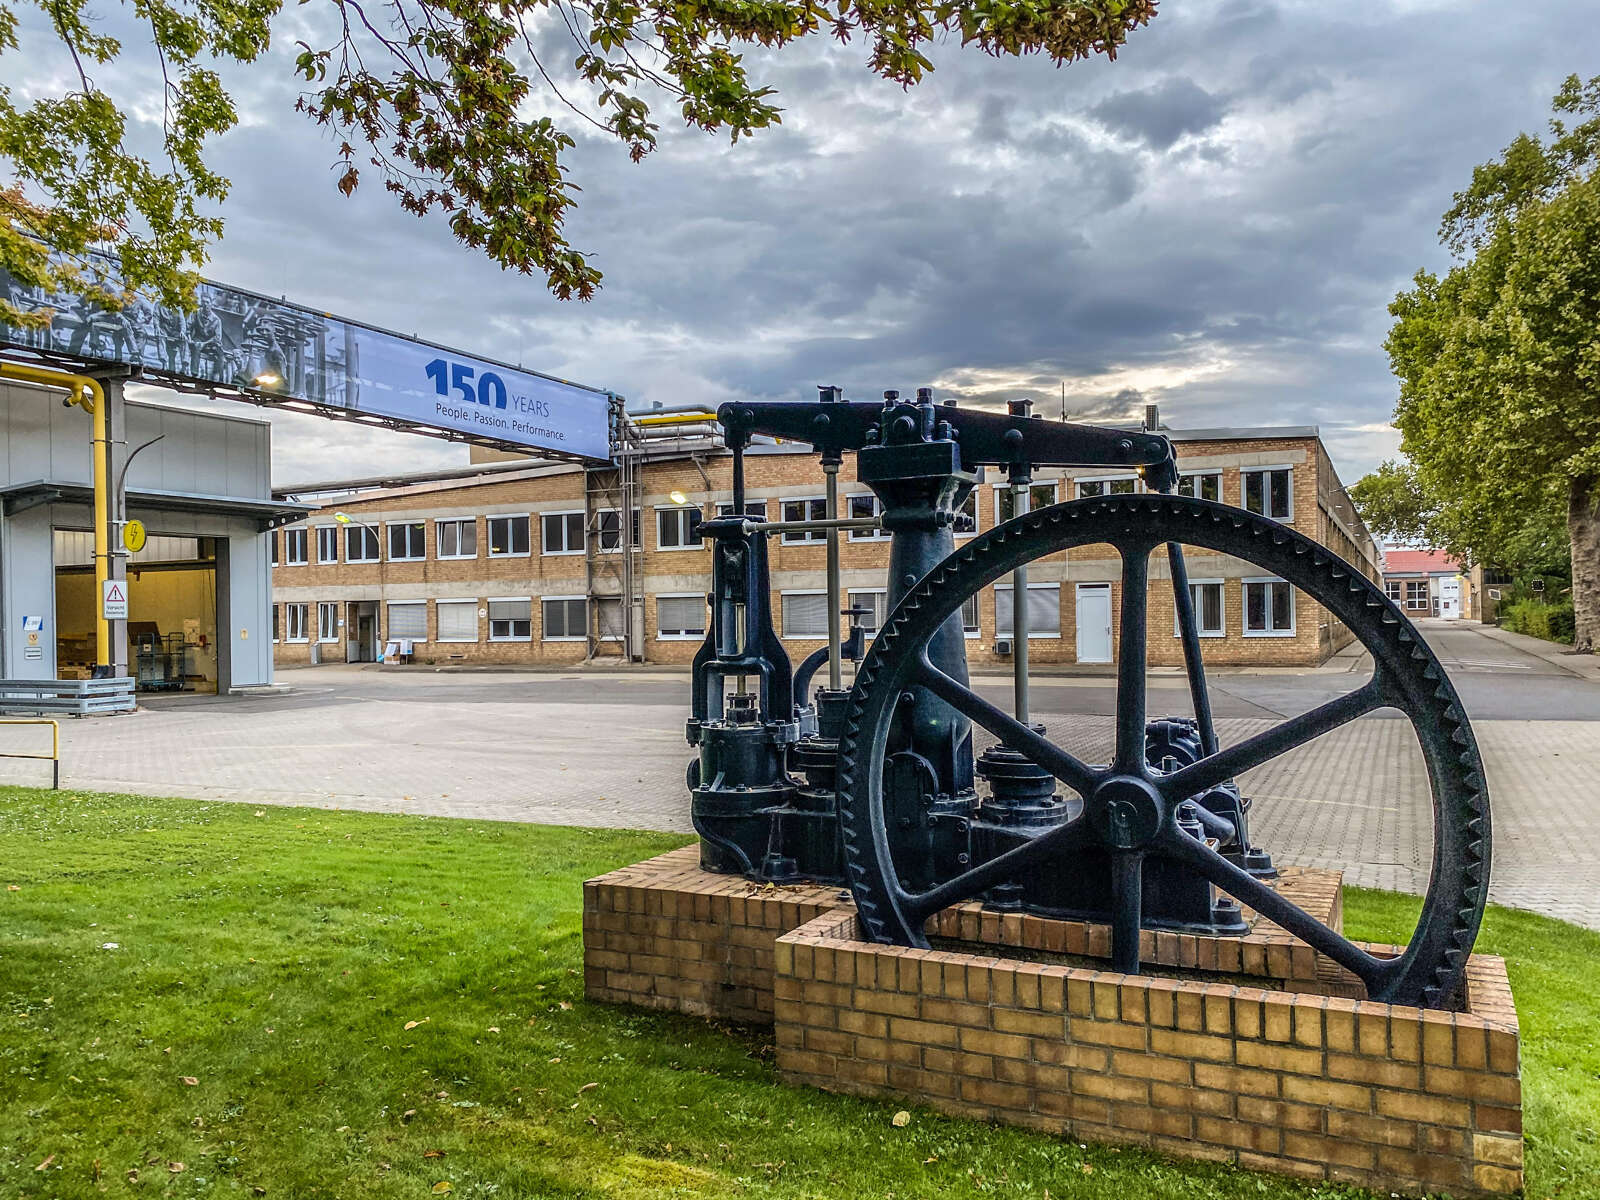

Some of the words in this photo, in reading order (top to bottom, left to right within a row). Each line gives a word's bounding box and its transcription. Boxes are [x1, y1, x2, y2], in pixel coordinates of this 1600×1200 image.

[425, 358, 507, 409] 150
[512, 394, 550, 418] YEARS
[436, 402, 471, 422] People.
[474, 411, 510, 430] Passion.
[512, 420, 566, 441] Performance.
